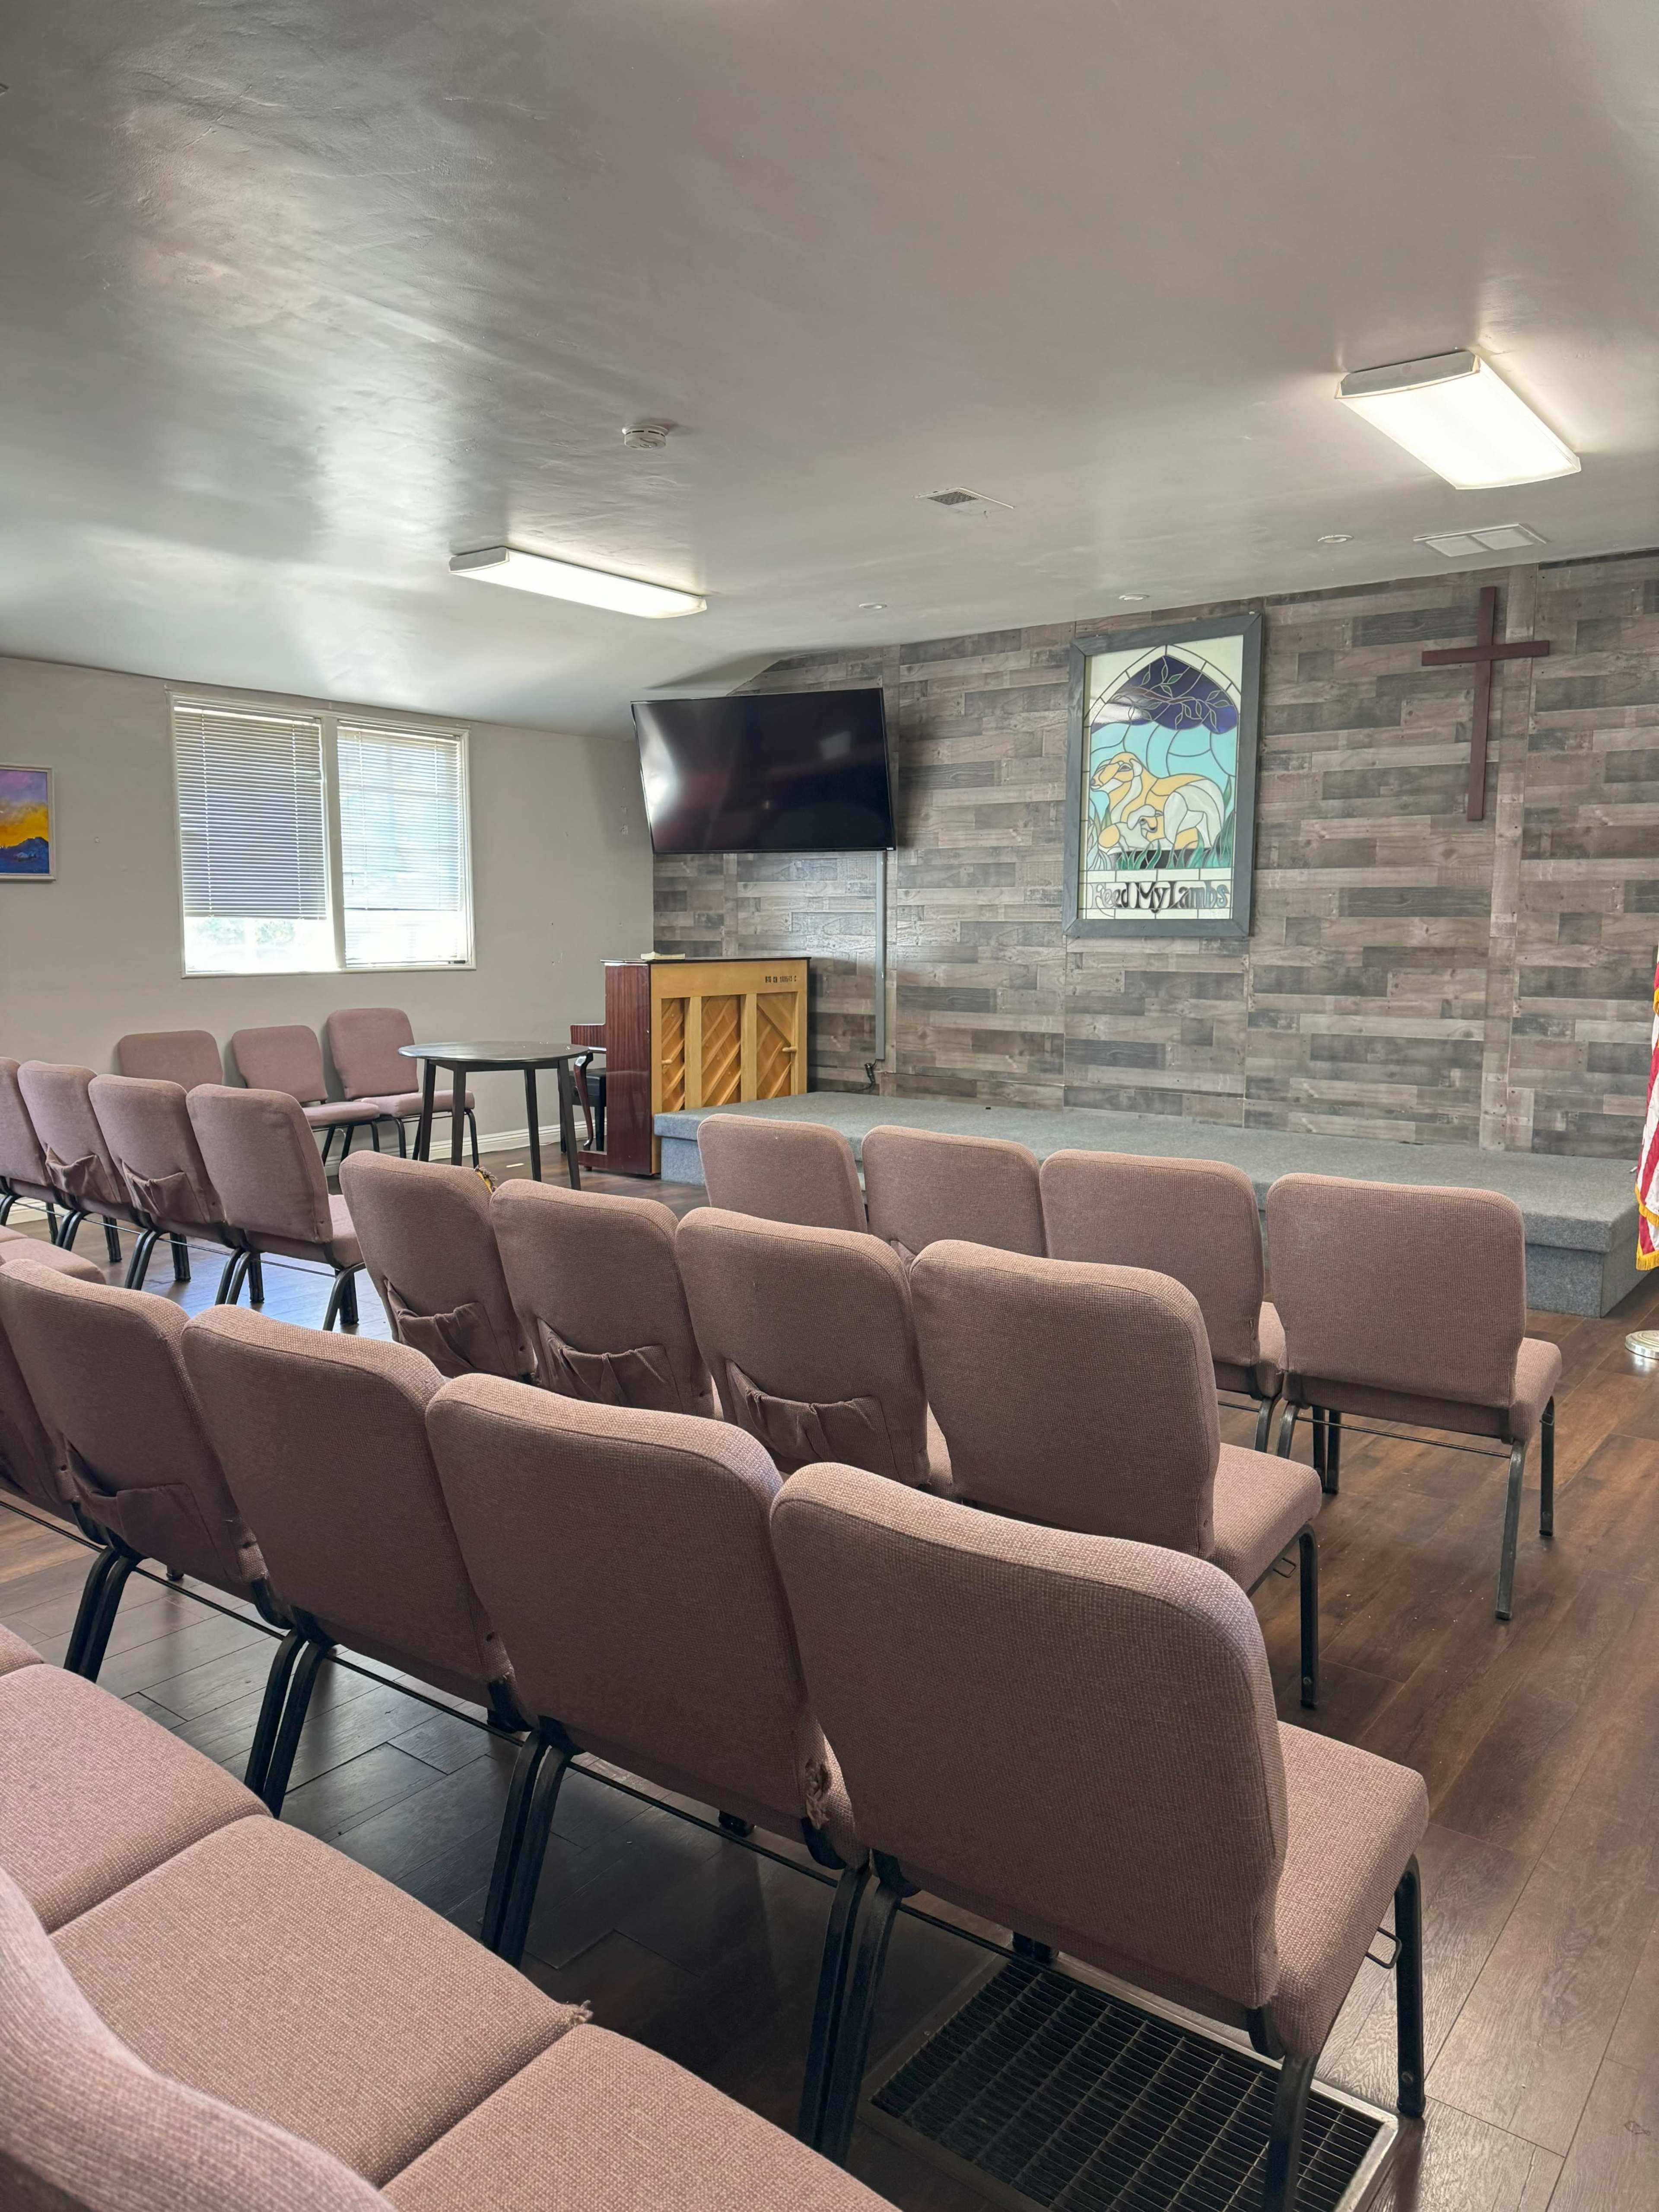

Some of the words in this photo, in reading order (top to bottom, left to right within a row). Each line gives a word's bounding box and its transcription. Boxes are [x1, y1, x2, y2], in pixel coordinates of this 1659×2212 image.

[1089, 882, 1129, 909] Feed
[1134, 882, 1170, 913] My
[1167, 881, 1230, 909] Lambs
